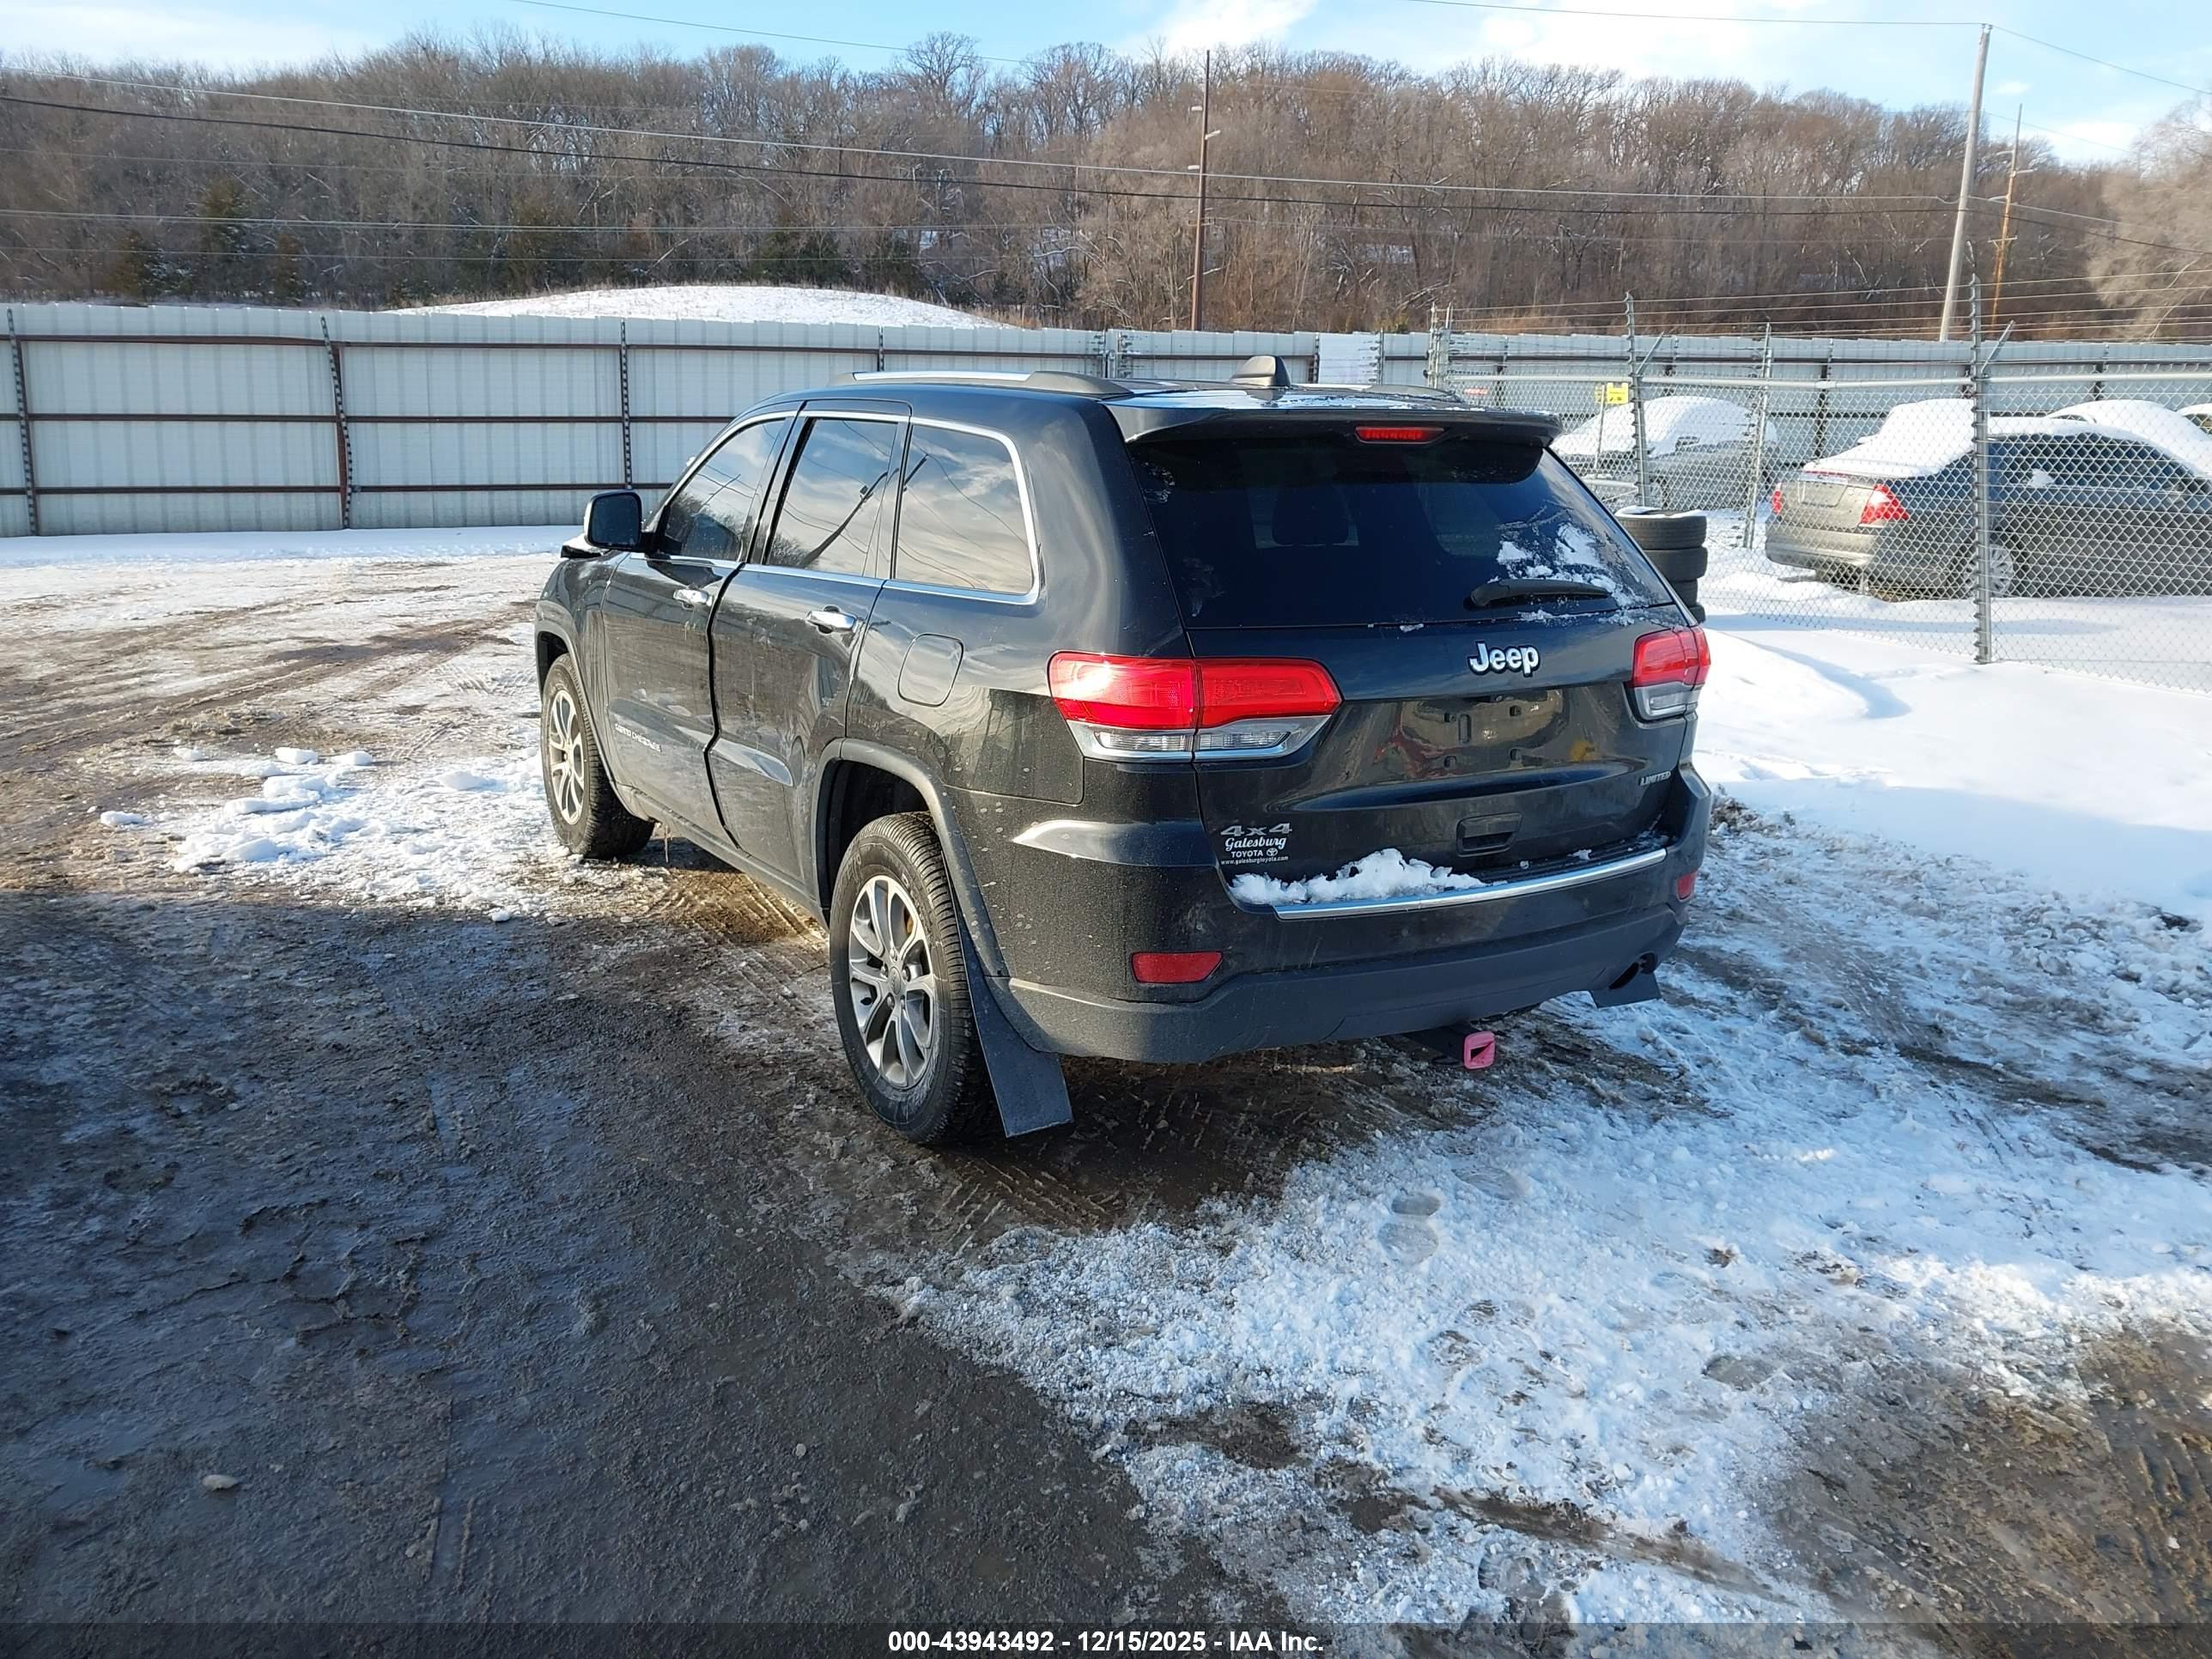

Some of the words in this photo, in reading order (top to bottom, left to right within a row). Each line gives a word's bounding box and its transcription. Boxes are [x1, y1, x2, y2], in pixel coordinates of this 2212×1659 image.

[1468, 642, 1540, 675] Jeep
[1220, 822, 1293, 837] 4x4
[1224, 836, 1287, 852] Galesburg
[1231, 849, 1264, 858] TOYOTA
